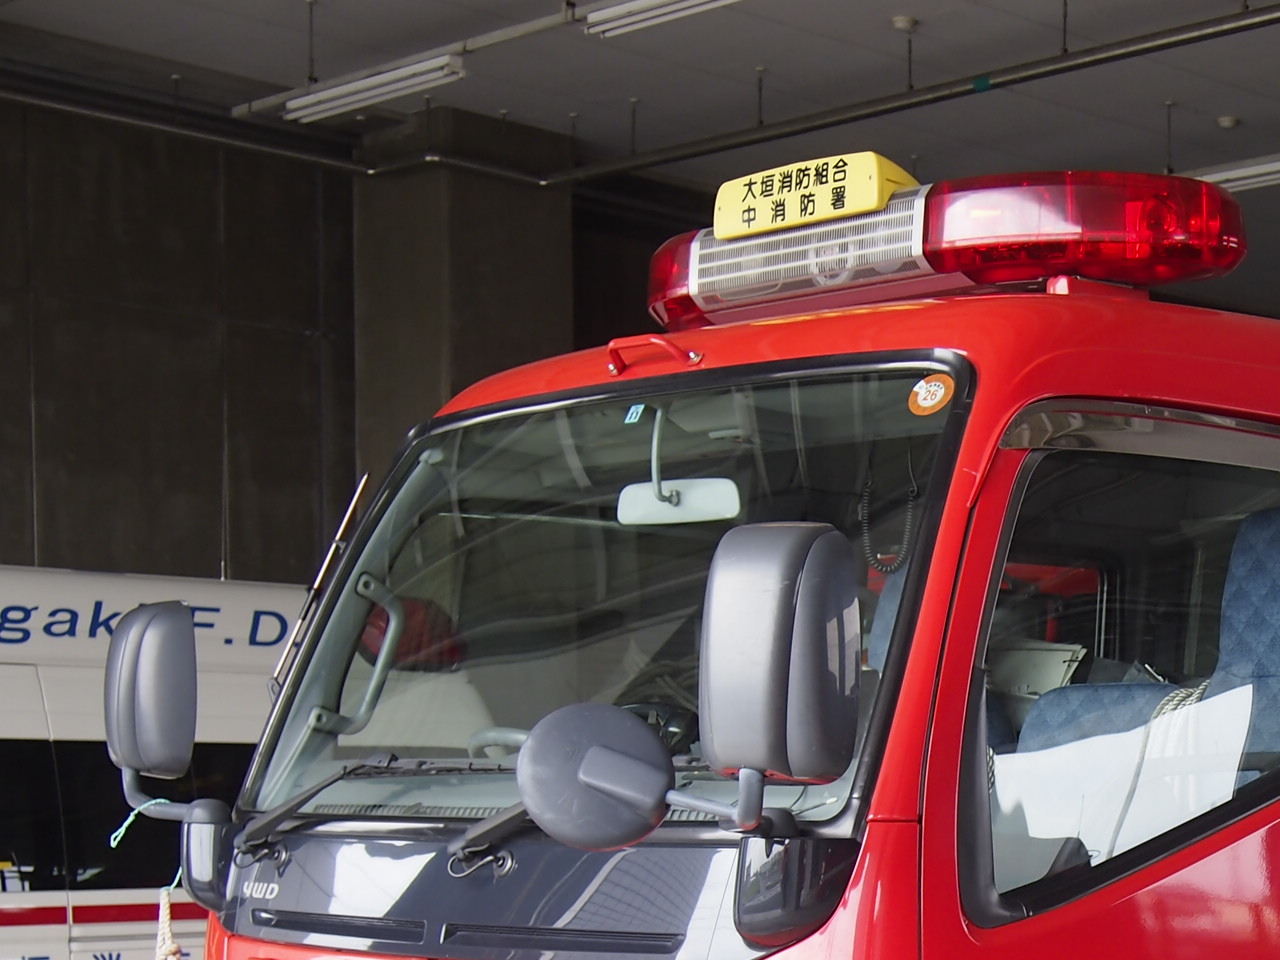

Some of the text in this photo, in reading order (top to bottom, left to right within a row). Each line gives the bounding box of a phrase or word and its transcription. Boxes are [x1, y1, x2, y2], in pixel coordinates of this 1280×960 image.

[742, 158, 848, 203] 大垣消防組合
[742, 185, 846, 229] 中消防署
[922, 389, 940, 402] 26
[243, 881, 279, 899] 4WD
